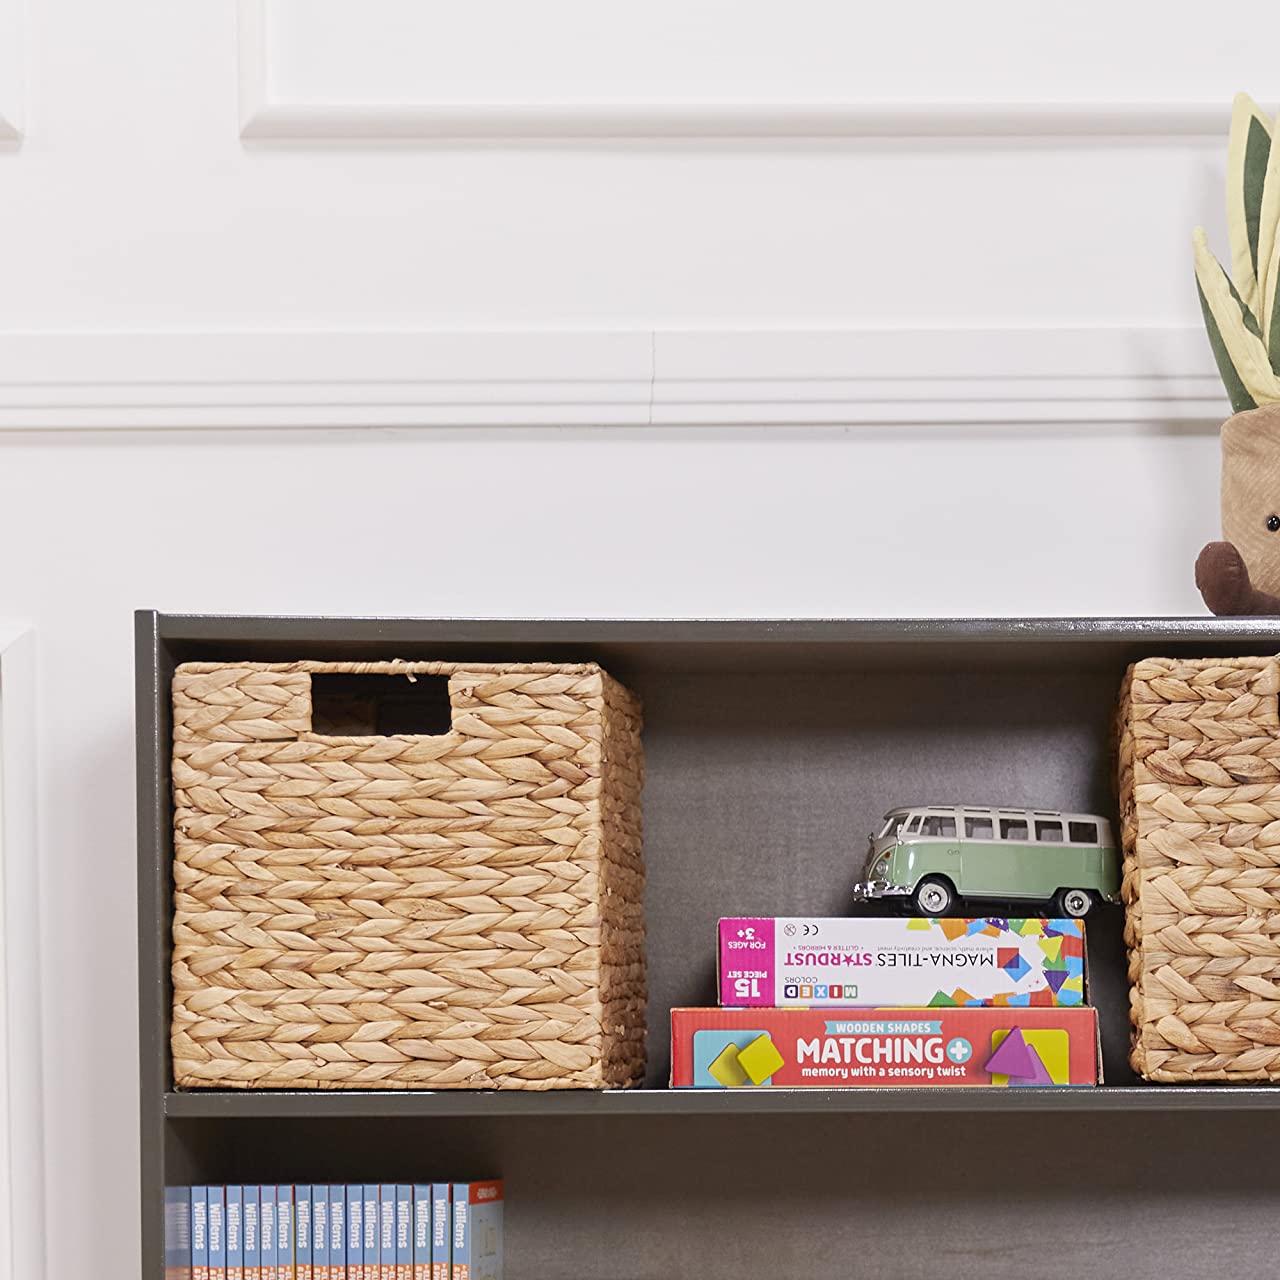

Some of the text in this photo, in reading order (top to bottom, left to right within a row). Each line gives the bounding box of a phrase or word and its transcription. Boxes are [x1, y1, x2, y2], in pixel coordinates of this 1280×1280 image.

[728, 941, 766, 949] FOR AGES
[737, 927, 755, 940] 3+
[784, 976, 818, 984] COLORS
[877, 953, 994, 967] MAGNA-TILES
[734, 978, 760, 997] 15
[785, 986, 857, 998] MIXED
[836, 1023, 931, 1033] WOODEN SHAPES
[801, 1066, 966, 1078] memory with a sensory twist
[194, 1202, 204, 1249] Willems
[210, 1204, 220, 1250] Willems
[228, 1204, 239, 1250] Willems
[246, 1204, 256, 1250] Willems
[262, 1203, 272, 1250] Willems
[279, 1202, 289, 1248] Willems
[298, 1201, 308, 1248] Willems
[315, 1202, 325, 1249] Willems
[332, 1202, 342, 1249] Willems
[350, 1201, 360, 1248] Willems
[365, 1201, 376, 1248] Willems
[383, 1201, 392, 1248] Willems
[398, 1201, 408, 1248] Willems
[417, 1200, 428, 1247] Willems
[435, 1200, 445, 1246] Willems
[455, 1201, 466, 1248] Willems
